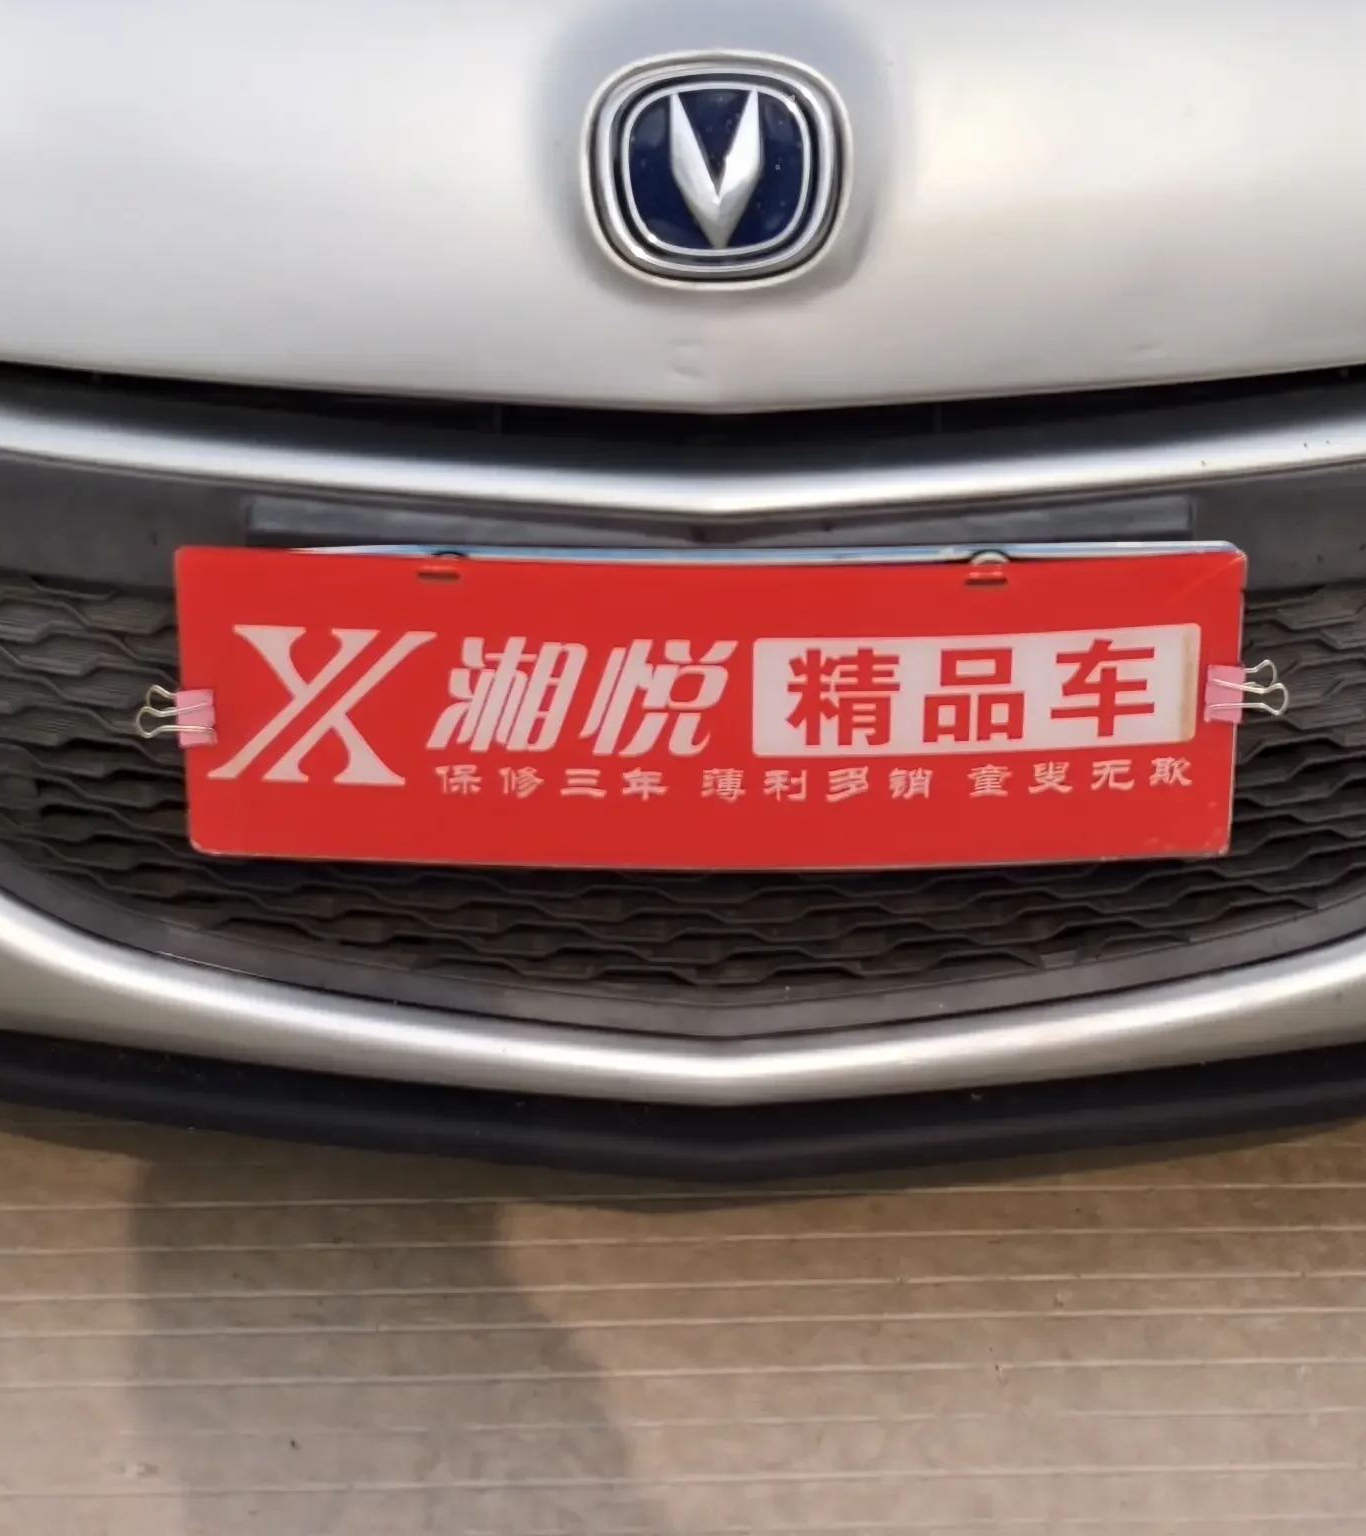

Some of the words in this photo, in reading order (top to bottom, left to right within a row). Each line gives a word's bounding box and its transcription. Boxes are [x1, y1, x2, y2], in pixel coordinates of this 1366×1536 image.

[425, 635, 739, 758] 湘悦
[785, 637, 1156, 747] 精品车
[435, 764, 668, 801] 保修三年
[700, 764, 935, 802] 薄利多销
[967, 755, 1193, 799] 童叟无欺
